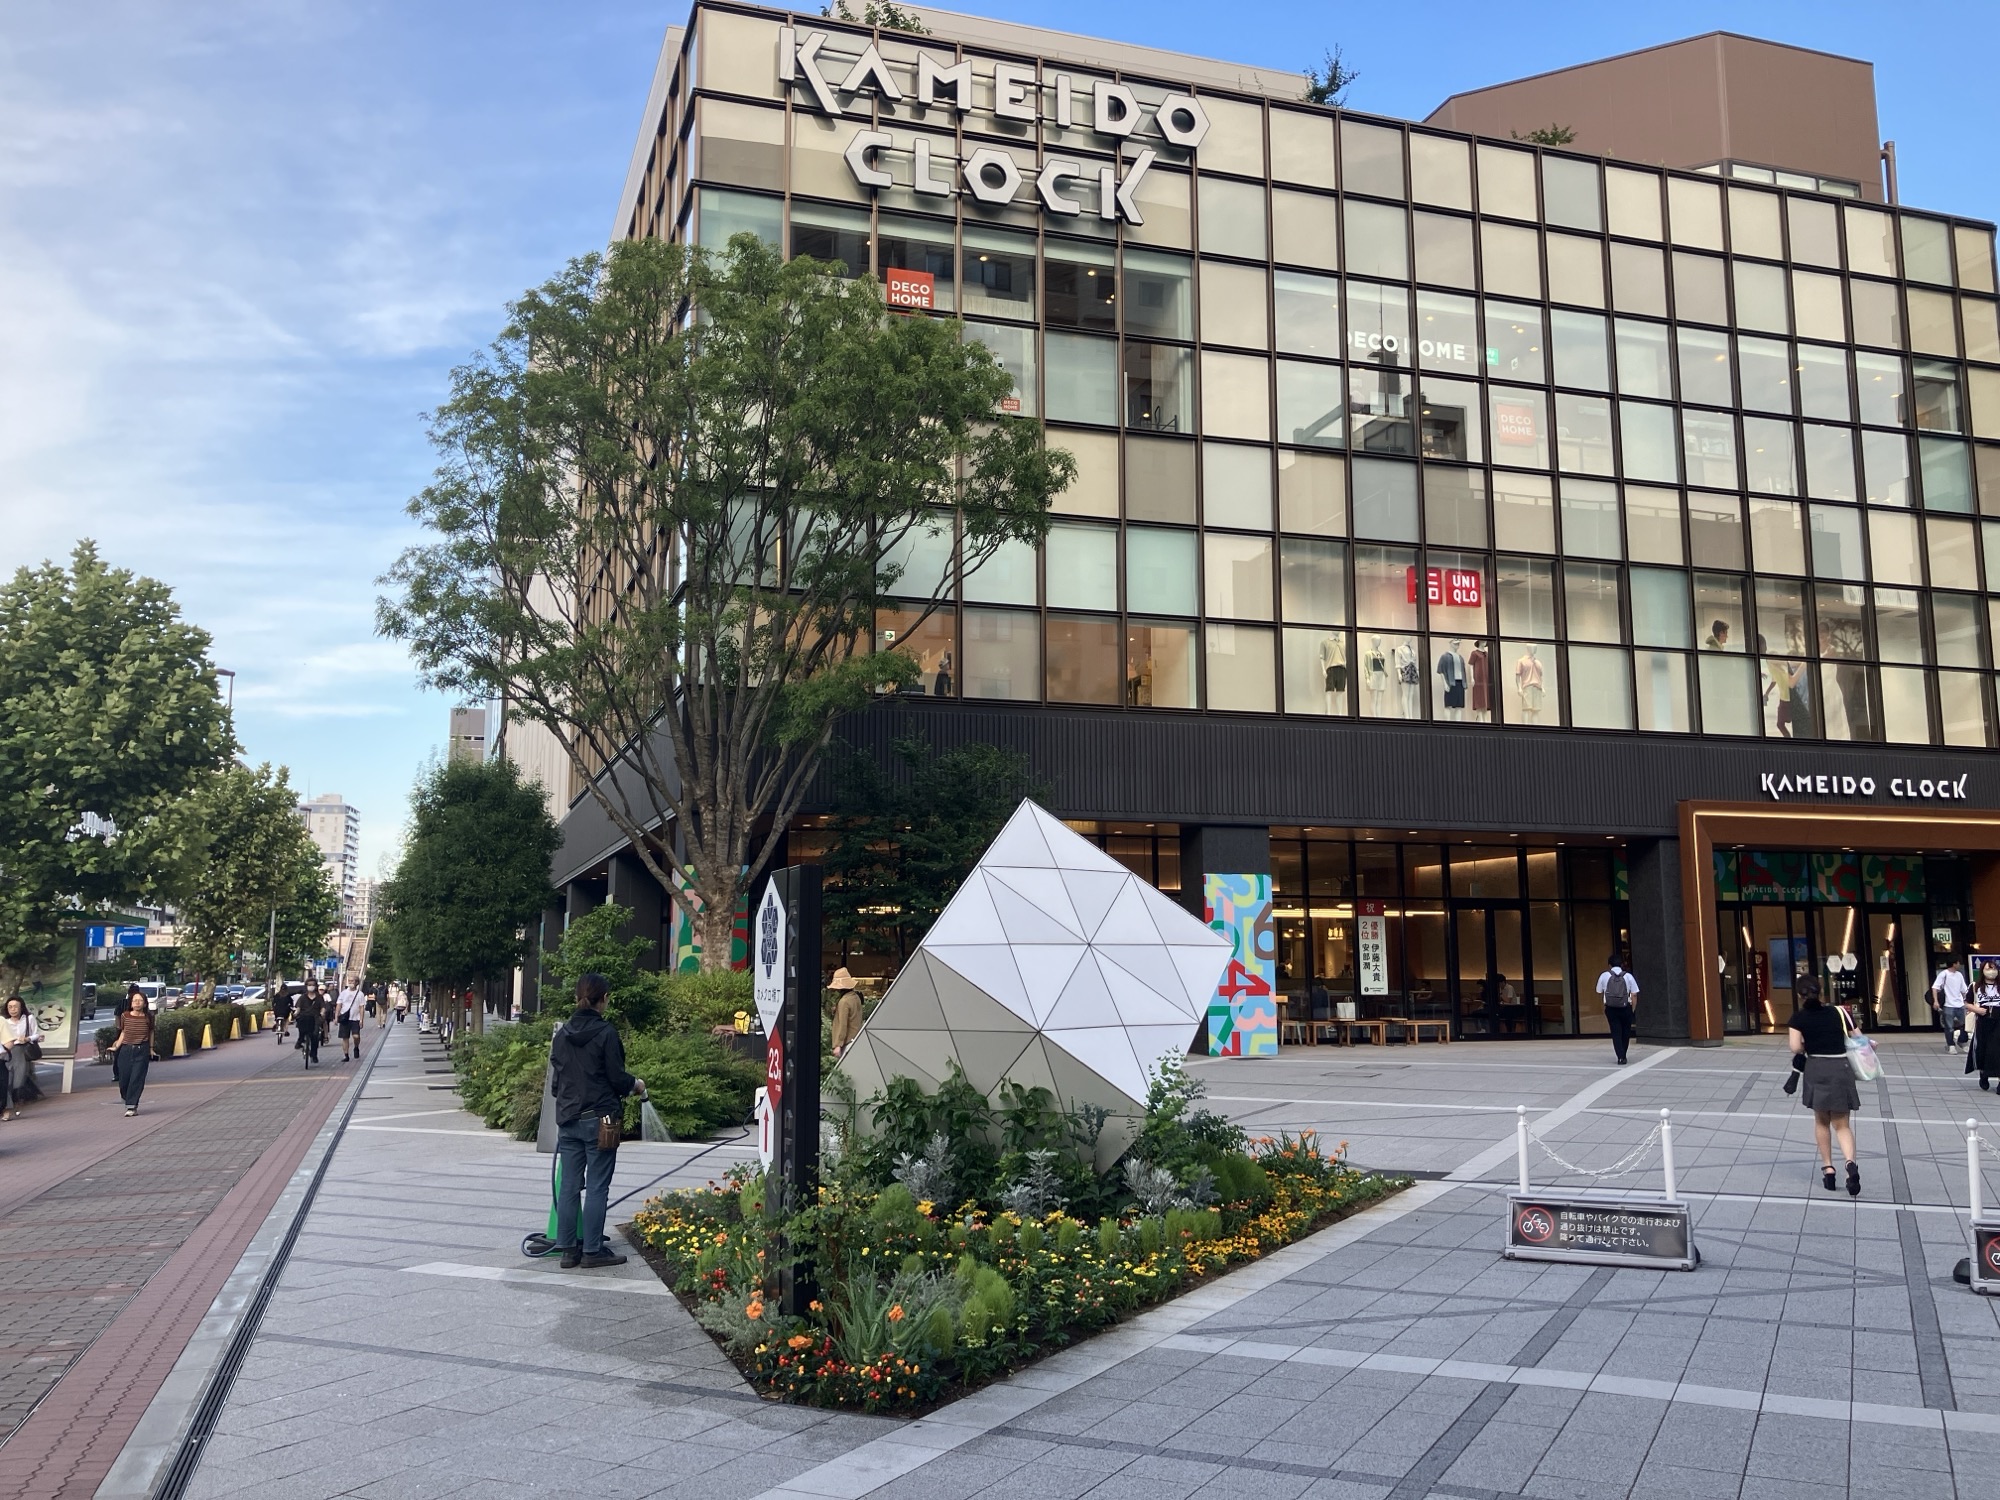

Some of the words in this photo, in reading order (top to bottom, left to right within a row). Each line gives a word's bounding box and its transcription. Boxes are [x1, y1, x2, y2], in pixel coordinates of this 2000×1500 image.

[778, 26, 1210, 148] KAMEIDO
[843, 129, 1157, 226] CLOCK
[891, 280, 930, 296] DECO
[891, 292, 930, 307] HOME
[1500, 413, 1531, 426] DECO
[1501, 424, 1533, 437] HOME
[1452, 574, 1475, 588] UNI
[1453, 588, 1478, 604] QLO
[1761, 772, 1876, 800] KAMEIDO
[1890, 773, 1968, 799] CLOCK
[1742, 886, 1778, 895] KAMEIDO
[1366, 903, 1375, 913] 祝
[1361, 921, 1370, 940] 2位
[1370, 921, 1379, 940] 優勝
[1371, 943, 1381, 982] 伊藤大貴
[769, 1047, 779, 1080] 23
[1559, 1211, 1681, 1228] 自転車やバイクでの走行および
[1559, 1222, 1642, 1236] 通り抜けは禁止です。
[1559, 1234, 1650, 1248] 降りて通行して下さい。
